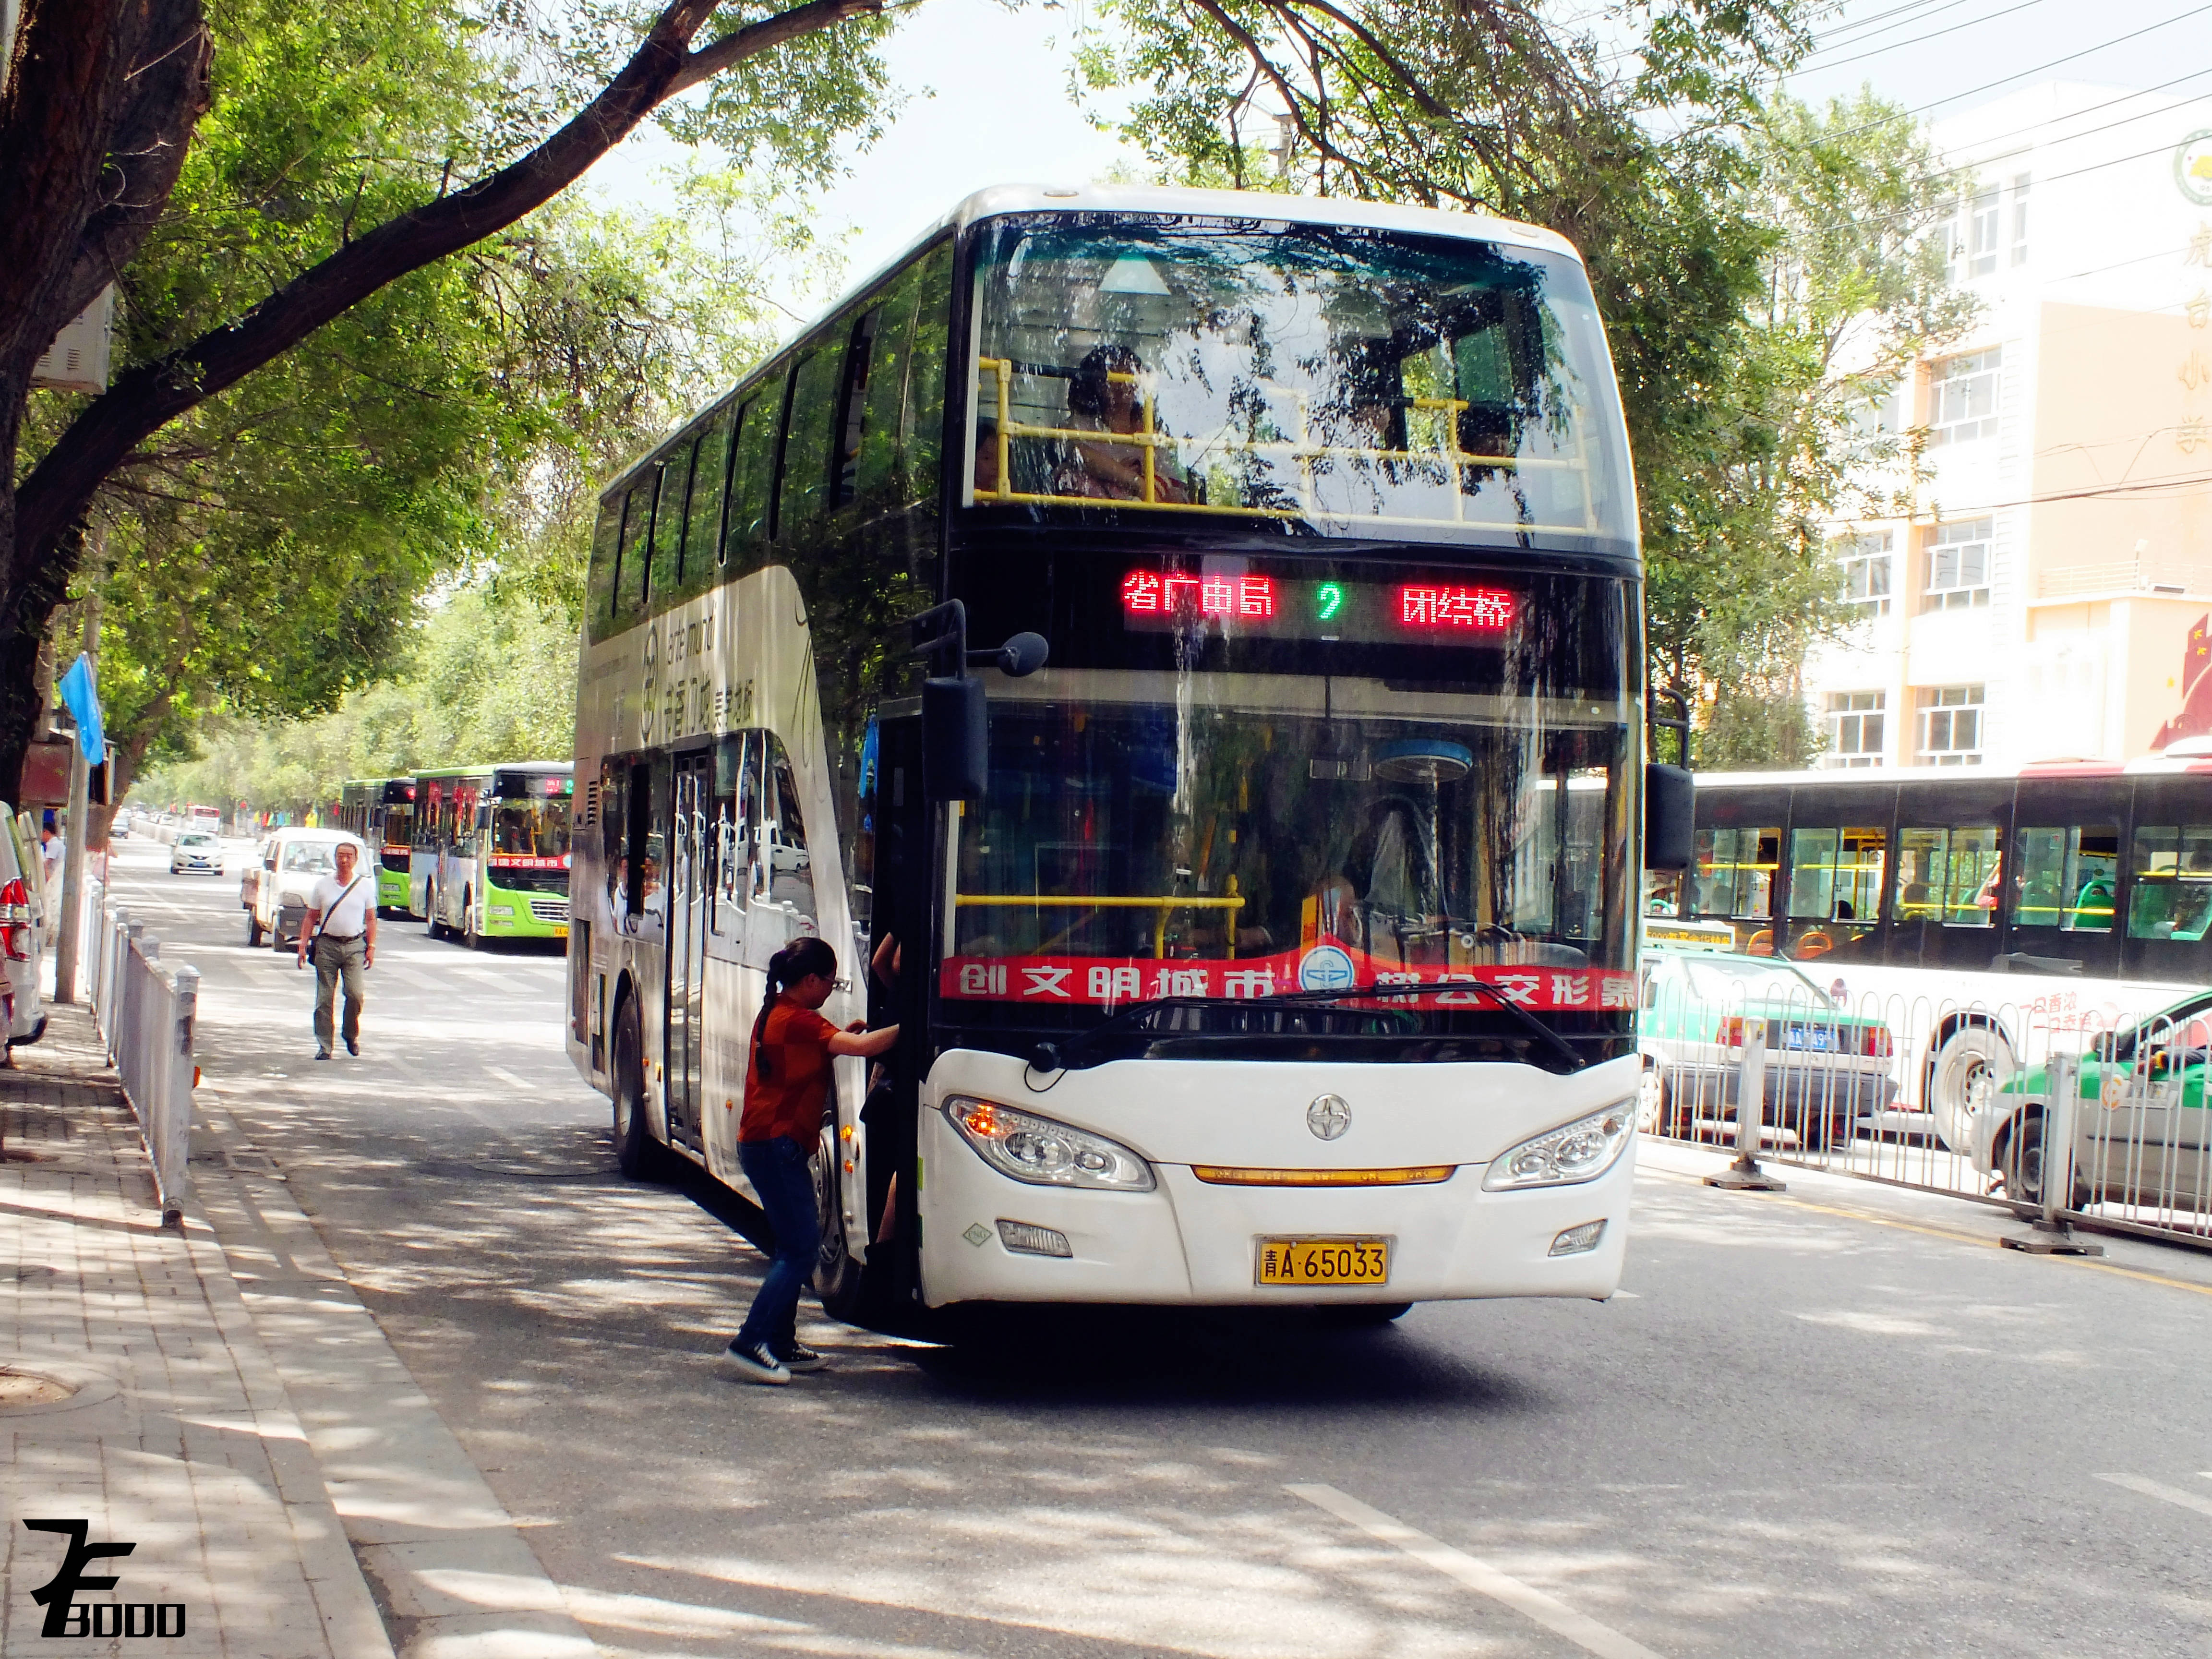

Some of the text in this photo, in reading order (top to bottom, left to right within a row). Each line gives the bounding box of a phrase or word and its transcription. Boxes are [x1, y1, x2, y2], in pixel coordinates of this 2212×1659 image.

[960, 964, 1275, 998] 创文明城市
